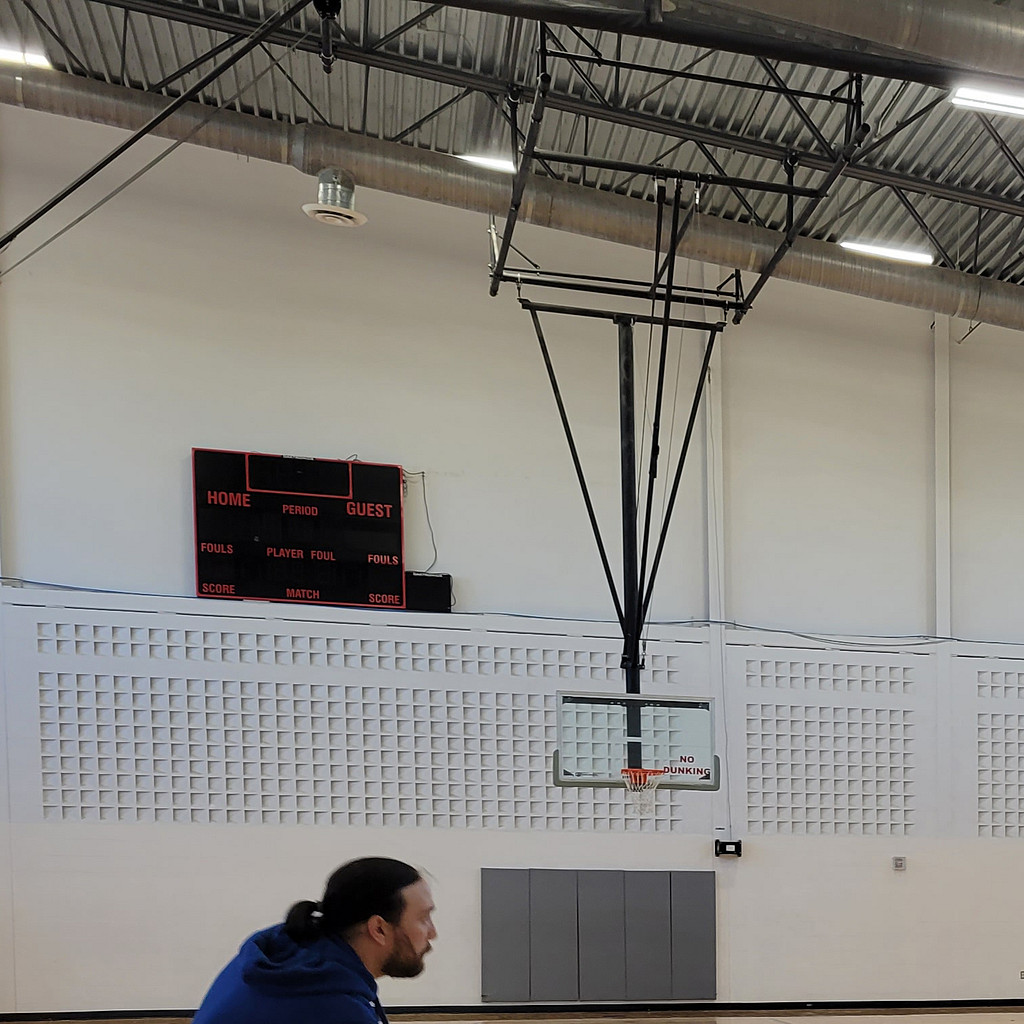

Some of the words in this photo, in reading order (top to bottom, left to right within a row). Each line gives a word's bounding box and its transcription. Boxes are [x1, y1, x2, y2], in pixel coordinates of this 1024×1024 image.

[207, 490, 251, 507] HOME
[282, 504, 318, 516] PERIOD
[346, 501, 392, 518] GUEST
[200, 542, 234, 554] FOULS
[266, 547, 304, 559] PLAYER
[310, 550, 336, 561] FOUL
[367, 554, 399, 566] FOULS
[202, 583, 236, 595] SCORE
[286, 588, 320, 600] MATCH
[368, 593, 400, 605] SCORE
[679, 755, 695, 763] NO
[663, 766, 711, 775] DUNKING
